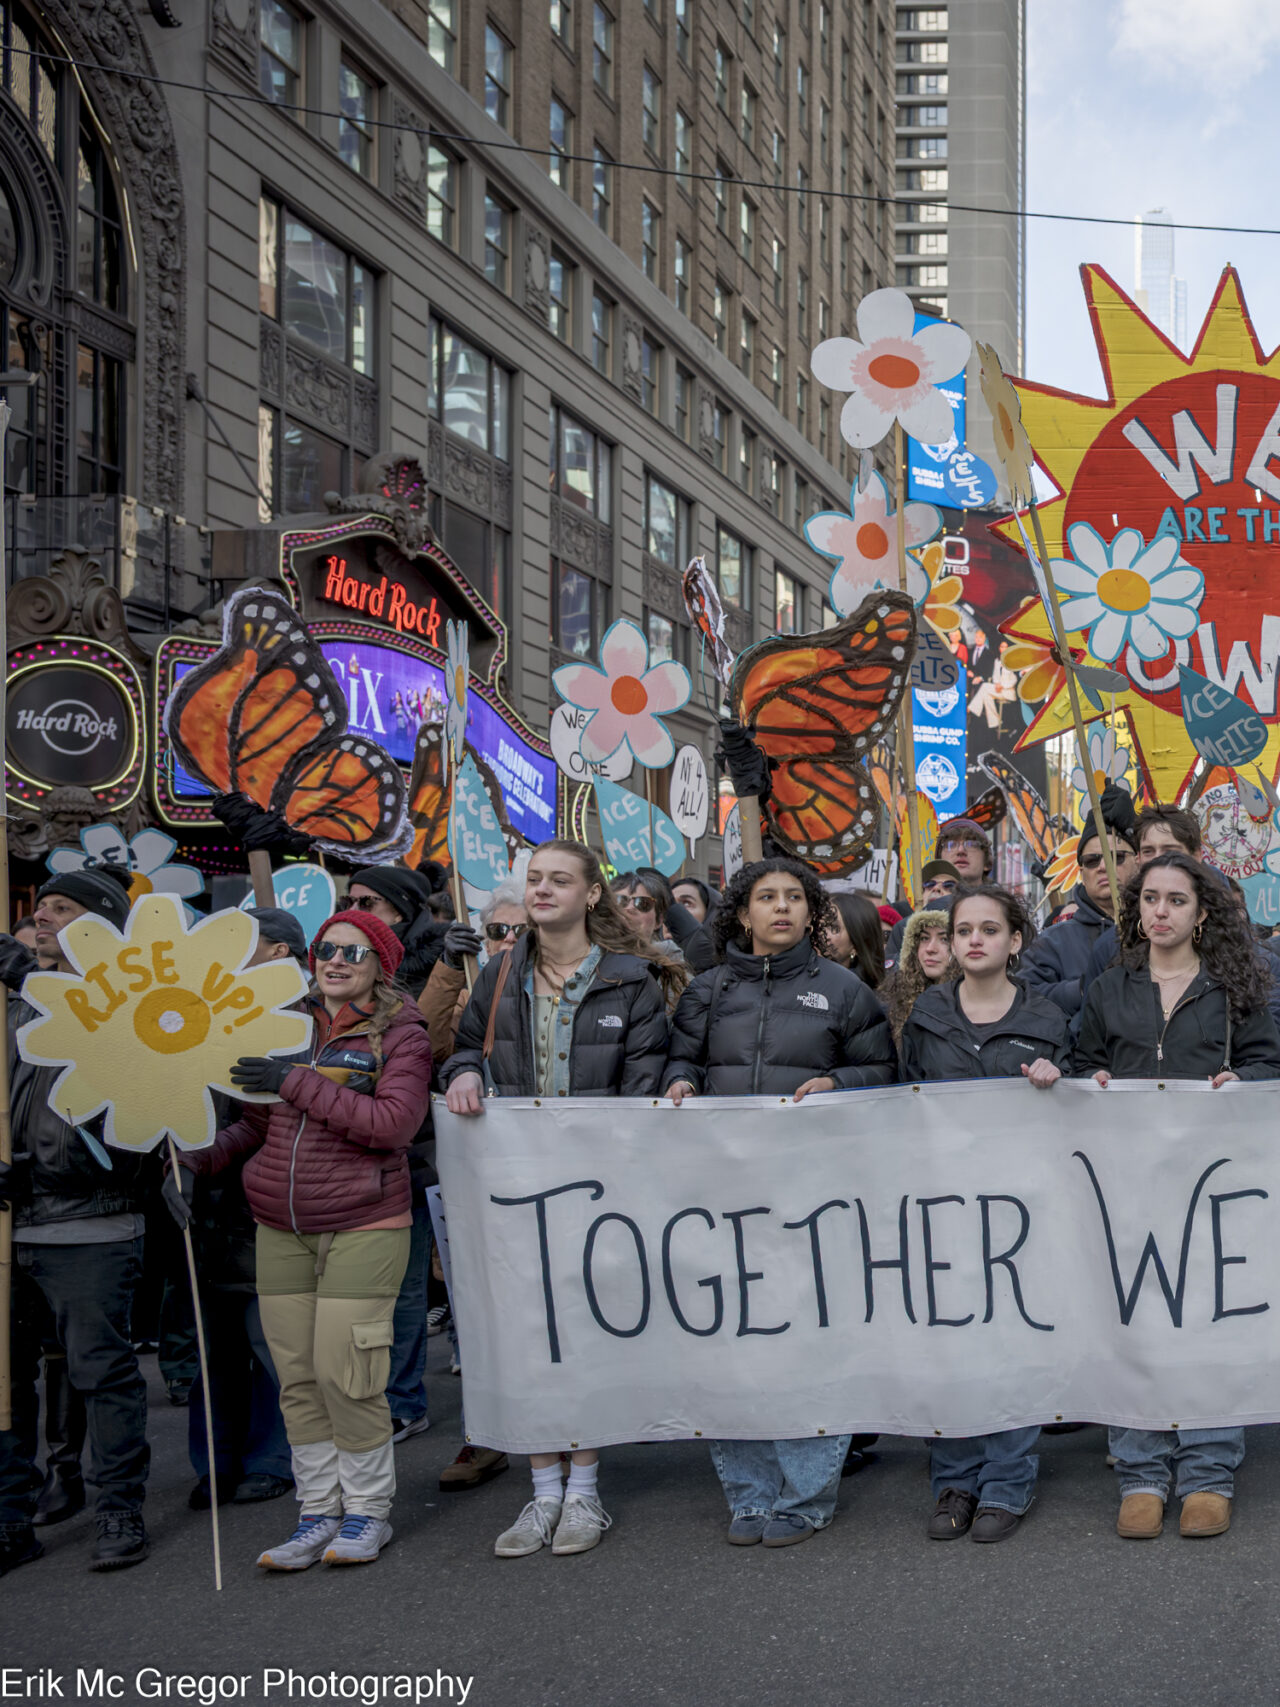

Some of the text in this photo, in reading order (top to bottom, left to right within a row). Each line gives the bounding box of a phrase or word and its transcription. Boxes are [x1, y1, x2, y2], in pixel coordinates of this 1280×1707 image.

[949, 452, 985, 506] MELTS
[1154, 506, 1230, 543] ARE
[325, 555, 442, 649] Hard Rock
[561, 709, 586, 729] We
[1183, 682, 1232, 723] ICE
[16, 709, 118, 740] Hard Rock
[1194, 715, 1266, 766] MELTS
[680, 757, 702, 792] NY 4
[455, 777, 495, 832] ICE
[602, 793, 641, 826] ICE
[677, 787, 704, 821] ALL!
[1204, 789, 1223, 804] NO
[454, 812, 507, 882] MELTS
[606, 819, 677, 865] MELTS
[64, 939, 264, 1035] RISE UP!
[490, 1180, 1055, 1363] TOGETHER
[1072, 1151, 1270, 1328] WE
